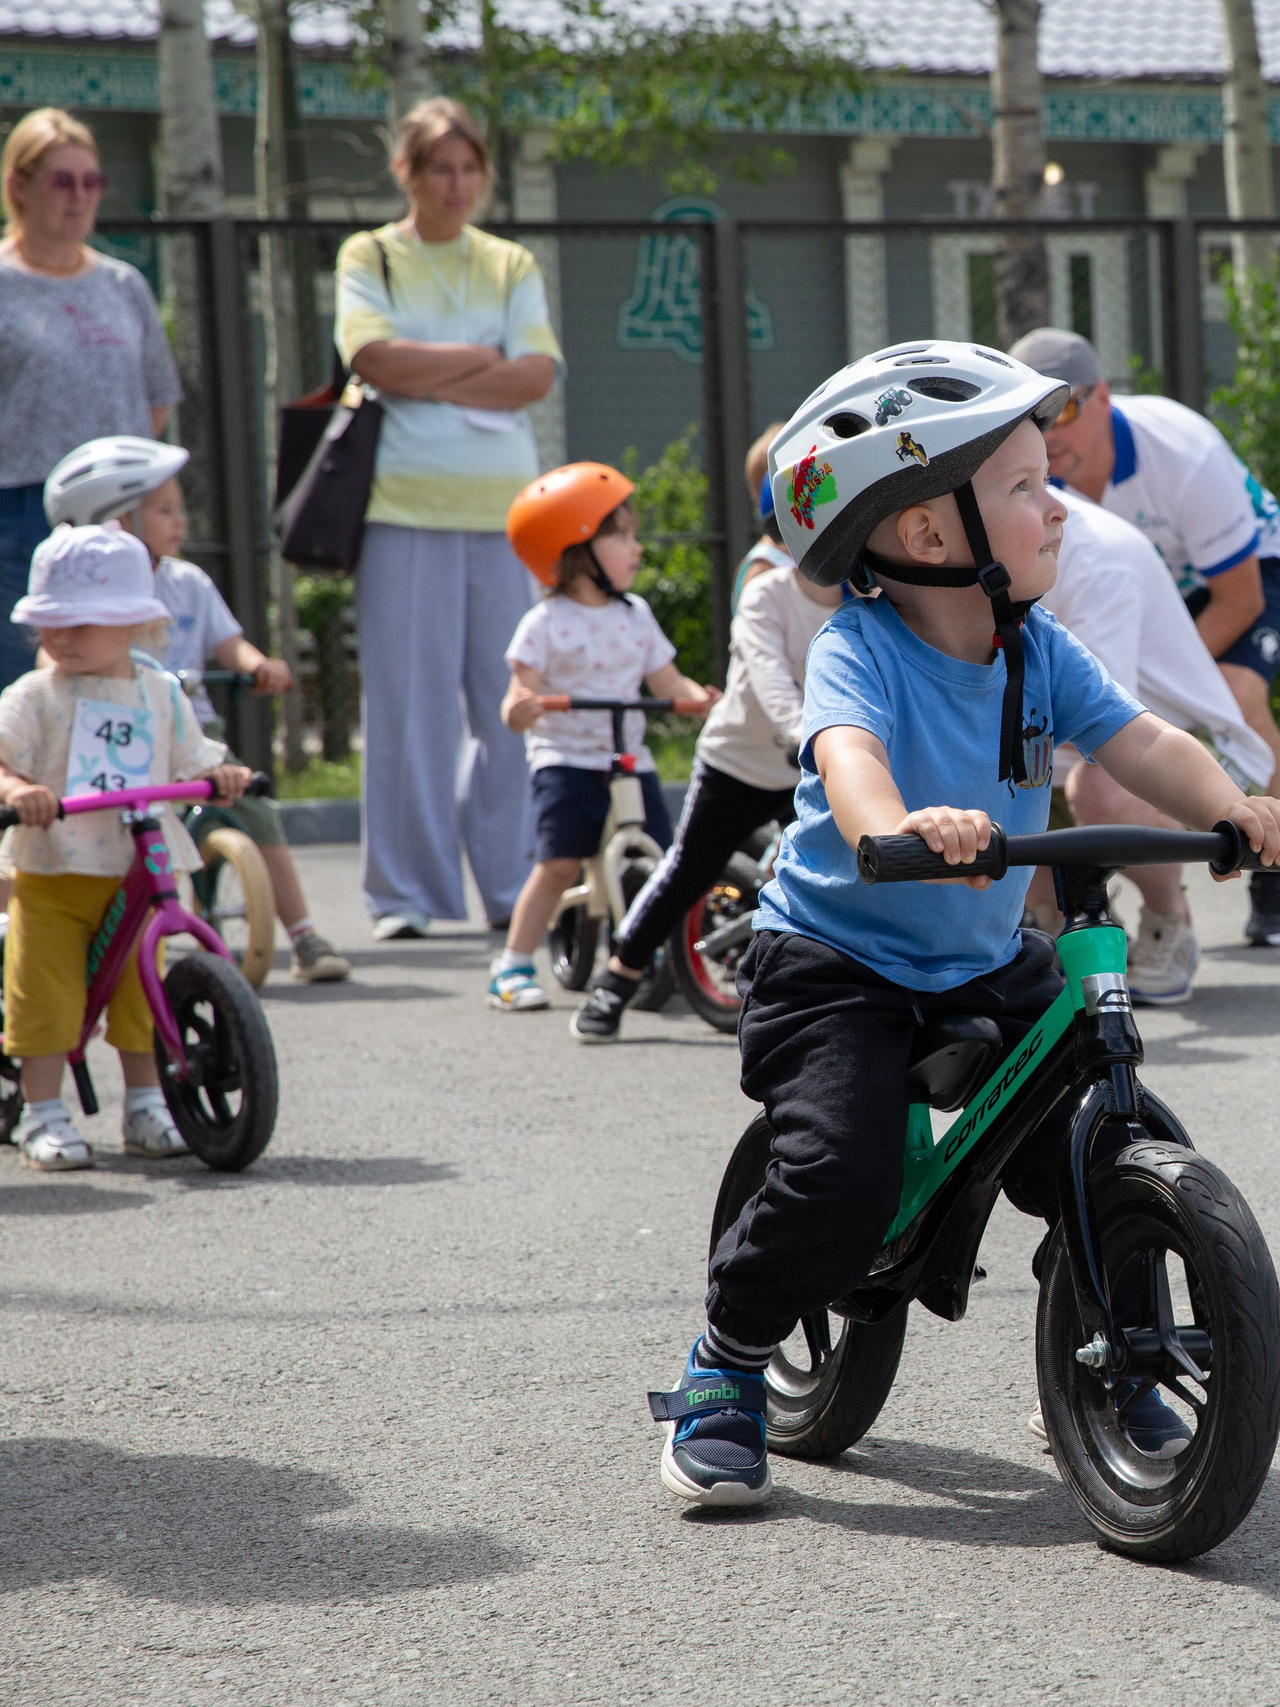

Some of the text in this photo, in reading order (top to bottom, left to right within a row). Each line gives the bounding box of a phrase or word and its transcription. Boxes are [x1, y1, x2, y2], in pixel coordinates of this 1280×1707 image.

[95, 720, 132, 746] 43
[90, 771, 126, 792] 43
[943, 1028, 1044, 1164] corratec
[686, 1383, 740, 1406] Tombi
